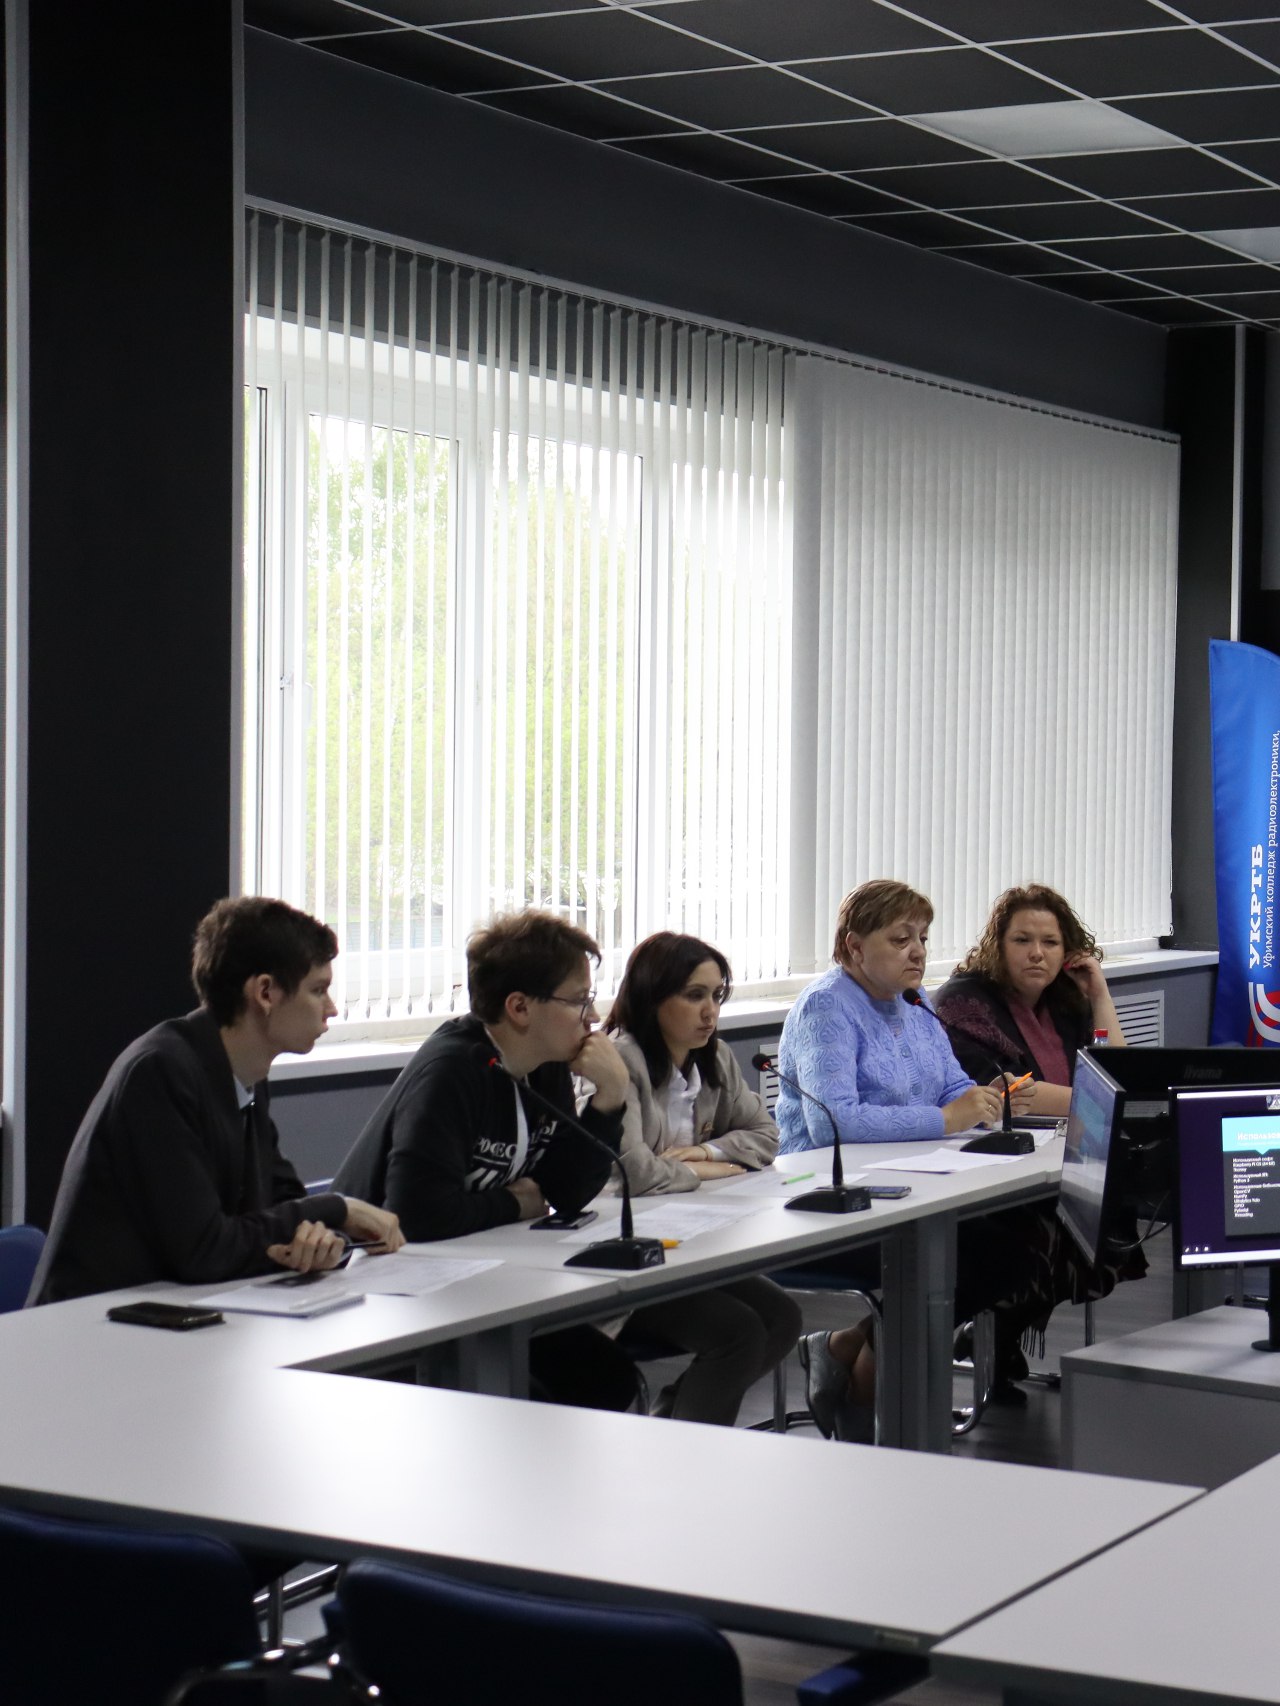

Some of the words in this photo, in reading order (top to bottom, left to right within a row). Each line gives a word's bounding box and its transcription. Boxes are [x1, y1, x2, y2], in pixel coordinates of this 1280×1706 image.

[1267, 730, 1280, 848] радиоэлектроники,
[1249, 844, 1263, 969] УКРТБ
[1266, 850, 1277, 903] колледж
[1262, 906, 1275, 969] Уфимский
